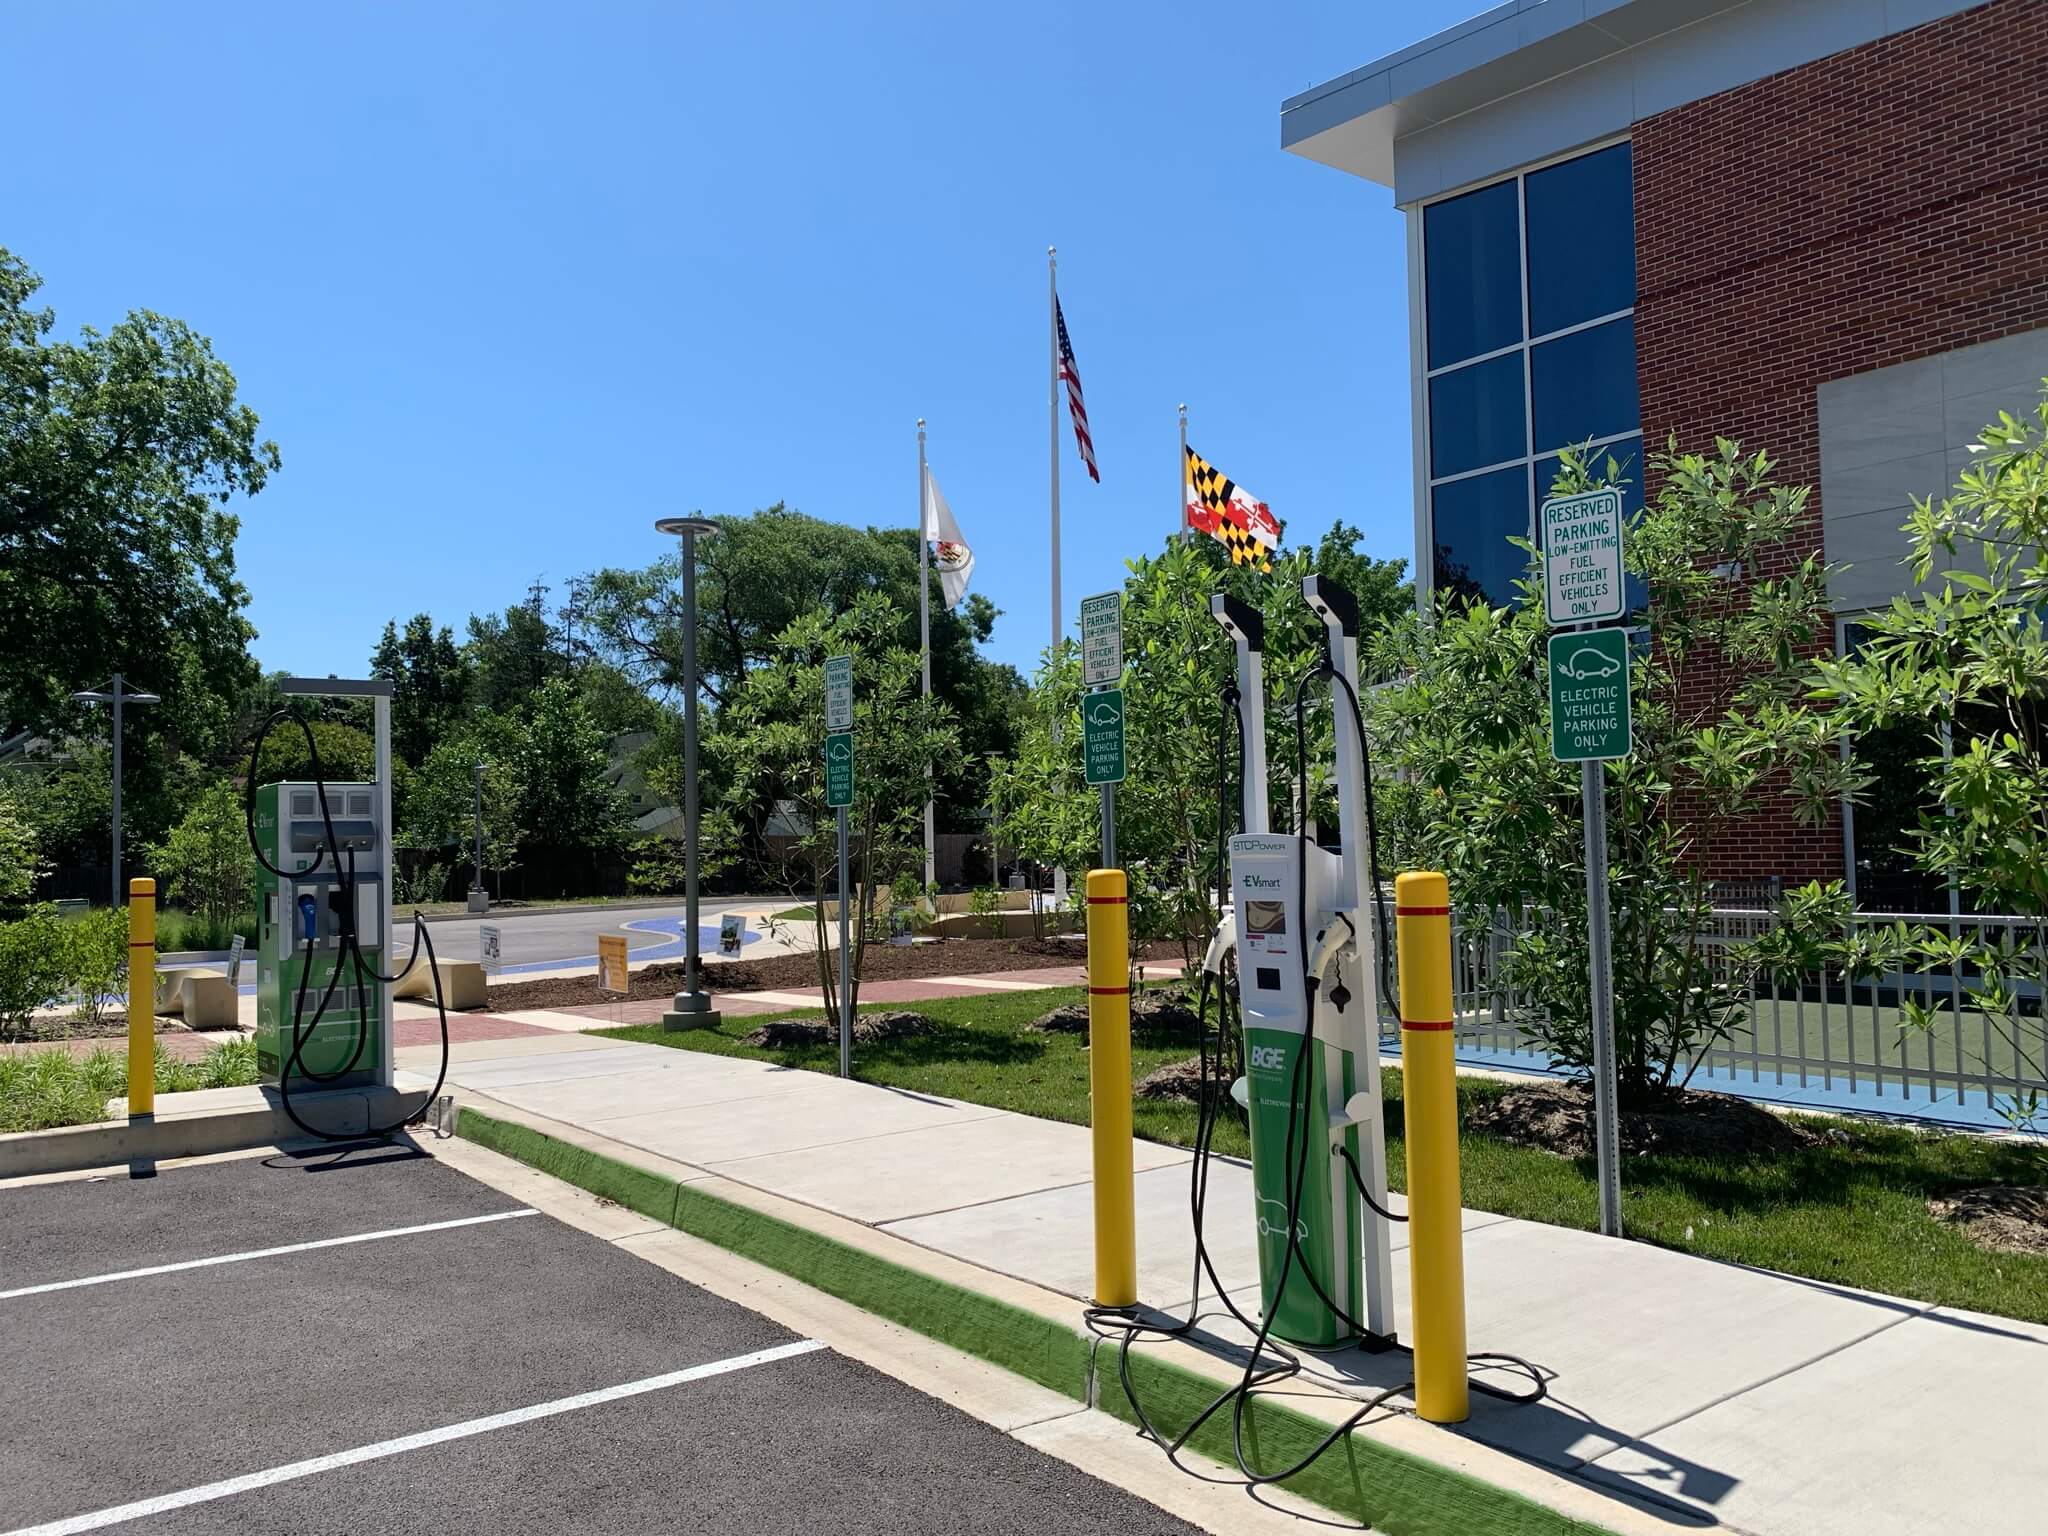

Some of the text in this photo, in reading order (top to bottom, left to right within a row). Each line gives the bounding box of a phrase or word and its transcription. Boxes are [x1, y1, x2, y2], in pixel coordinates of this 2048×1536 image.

[1548, 498, 1614, 524] RESERVED
[1554, 520, 1610, 543] PARKING
[1549, 535, 1617, 558] LOW-EMITTING
[1570, 556, 1595, 569] FUEL
[1559, 568, 1607, 586] EFFICIENT
[1561, 584, 1608, 601] VEHICLES
[1084, 596, 1117, 614] RESERVED
[1571, 600, 1597, 615] ONLY
[1087, 612, 1116, 628] PARKING
[1561, 686, 1618, 703] ELECTRIC
[1564, 701, 1616, 718] VEHICLE
[1563, 718, 1617, 733] PARKING
[1089, 729, 1119, 743] ELECTRIC
[1574, 734, 1607, 748] ONLY
[1091, 742, 1118, 753] VEHICLE
[1091, 753, 1119, 764] PARKING
[1096, 764, 1114, 775] ONLY
[1251, 1046, 1285, 1070] BGE
